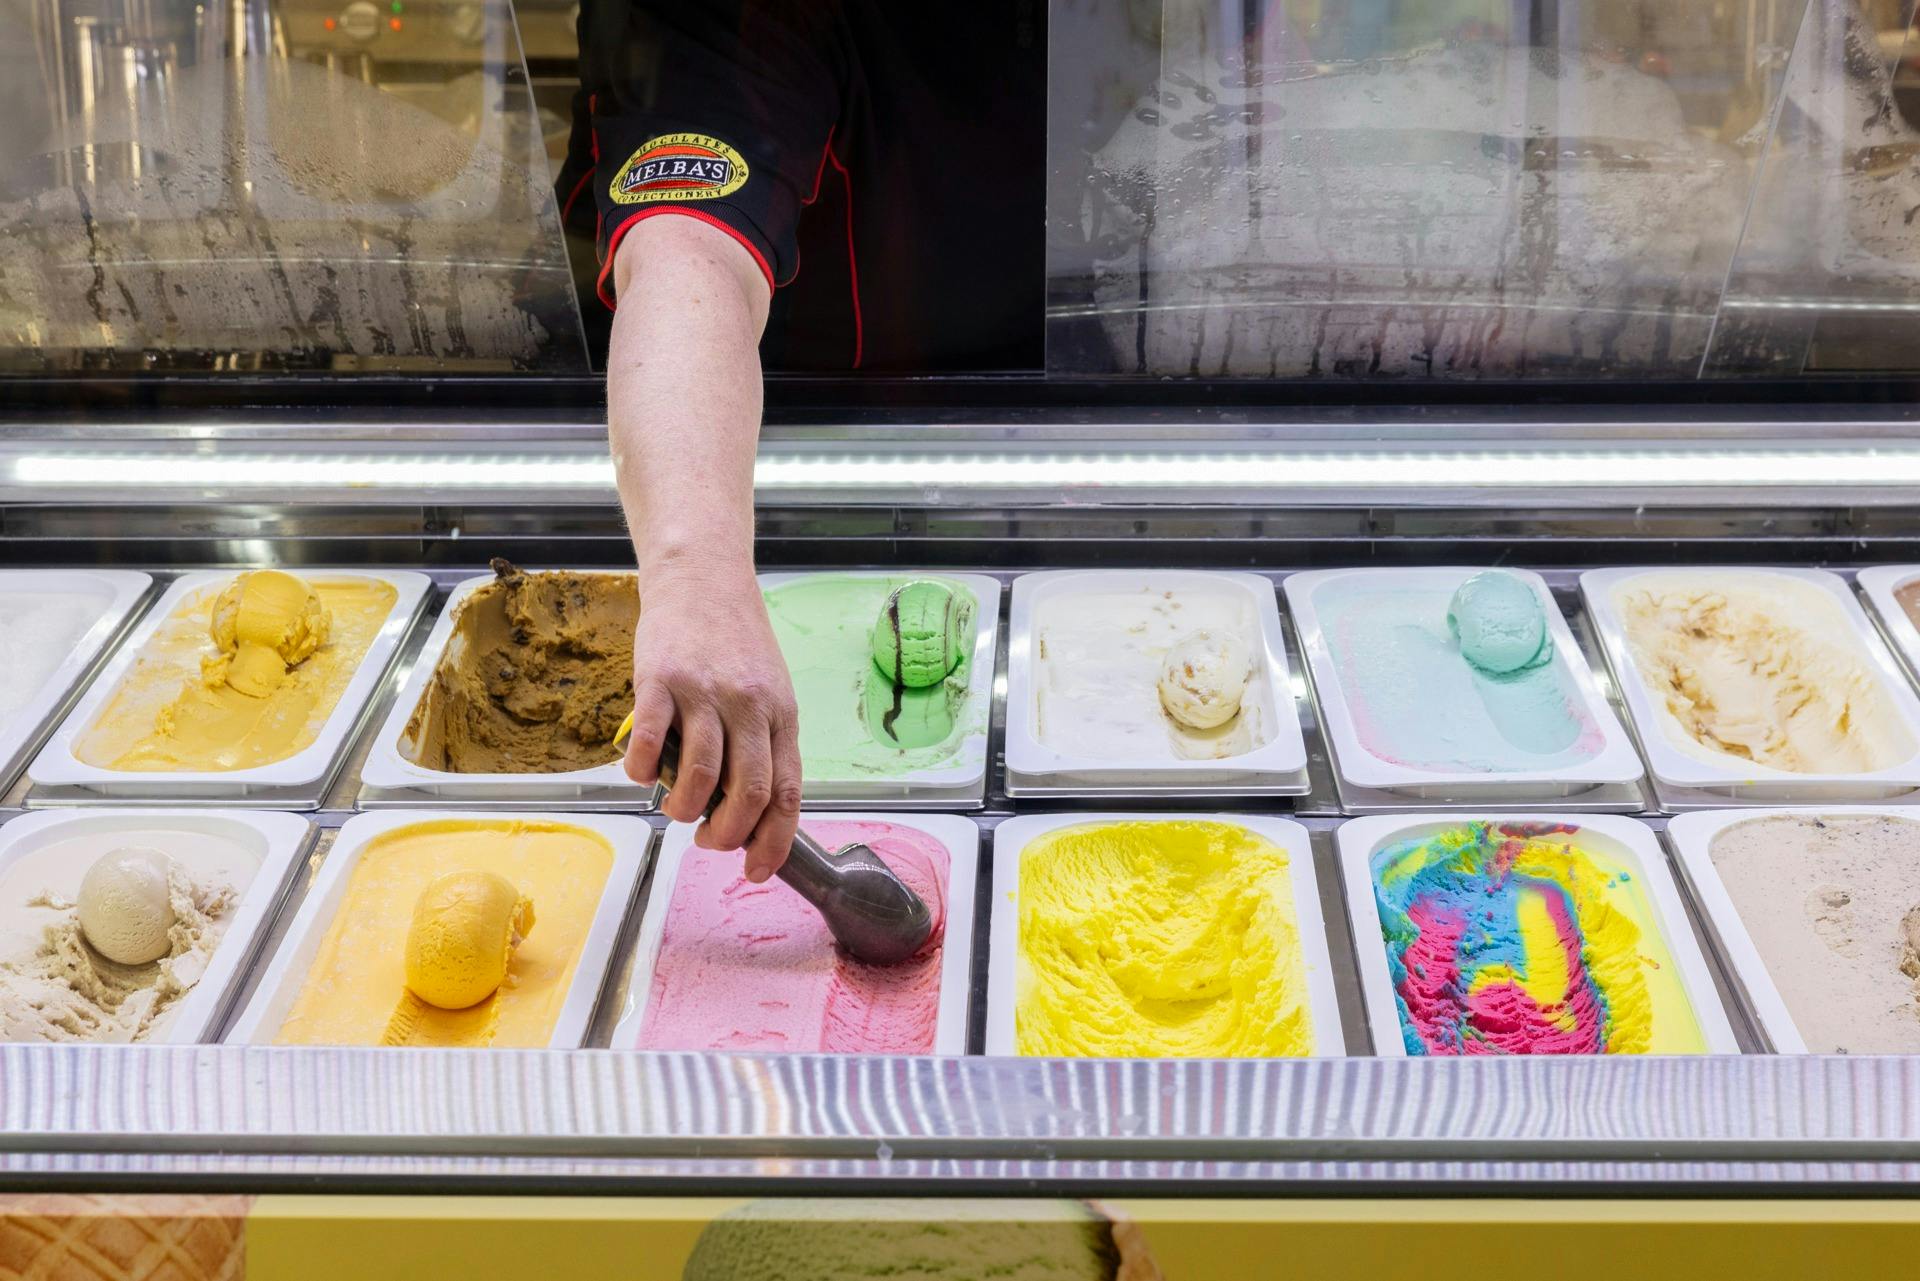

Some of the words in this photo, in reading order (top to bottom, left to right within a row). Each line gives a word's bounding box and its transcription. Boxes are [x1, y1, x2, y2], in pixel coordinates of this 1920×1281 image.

[630, 135, 731, 161] CHOCOLATES
[626, 160, 724, 186] MELBA'S
[617, 188, 722, 202] CONFECTIONERY
